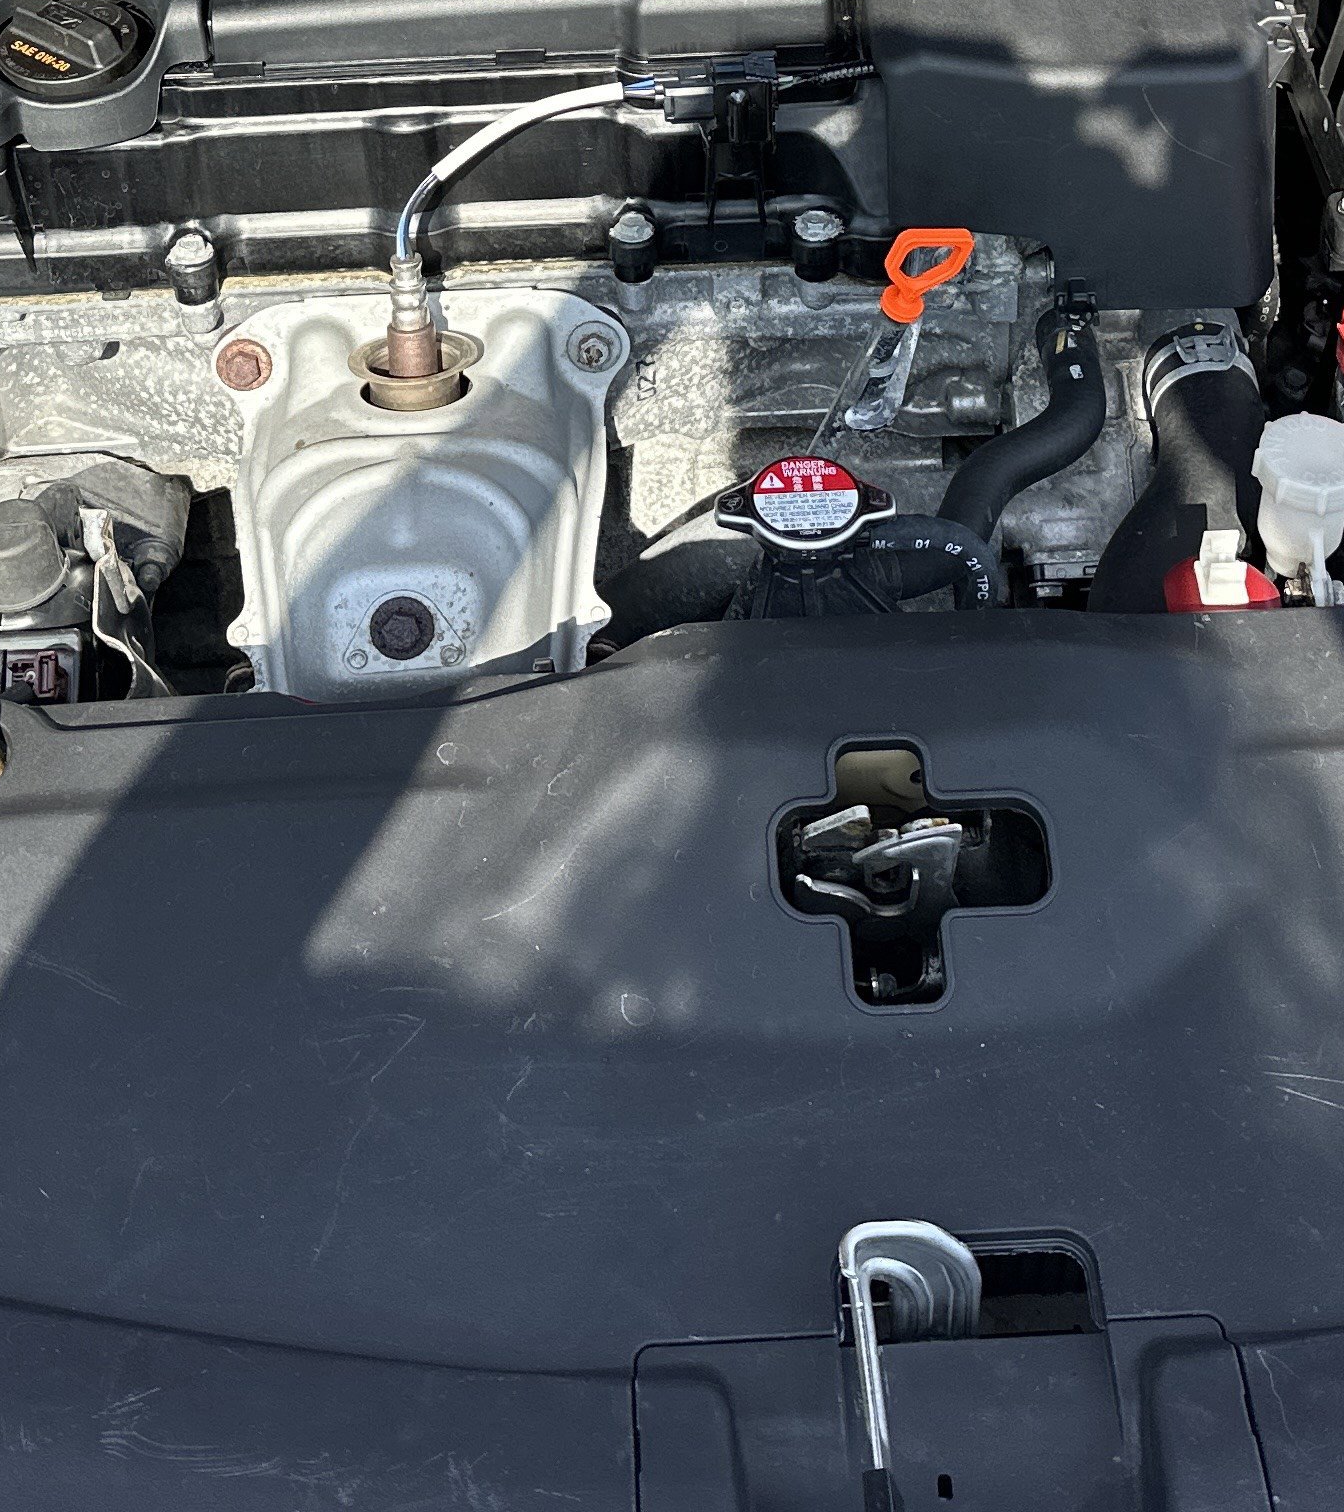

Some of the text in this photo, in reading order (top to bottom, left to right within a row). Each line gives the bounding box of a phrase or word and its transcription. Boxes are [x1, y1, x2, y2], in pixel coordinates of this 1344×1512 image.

[10, 39, 39, 56] SAE
[34, 51, 71, 72] 0W-20
[781, 460, 825, 471] DANGER
[782, 466, 837, 477] WARNUNG
[915, 539, 931, 549] 01
[944, 542, 963, 555] 02
[966, 557, 982, 571] 21
[976, 574, 989, 601] TPC
